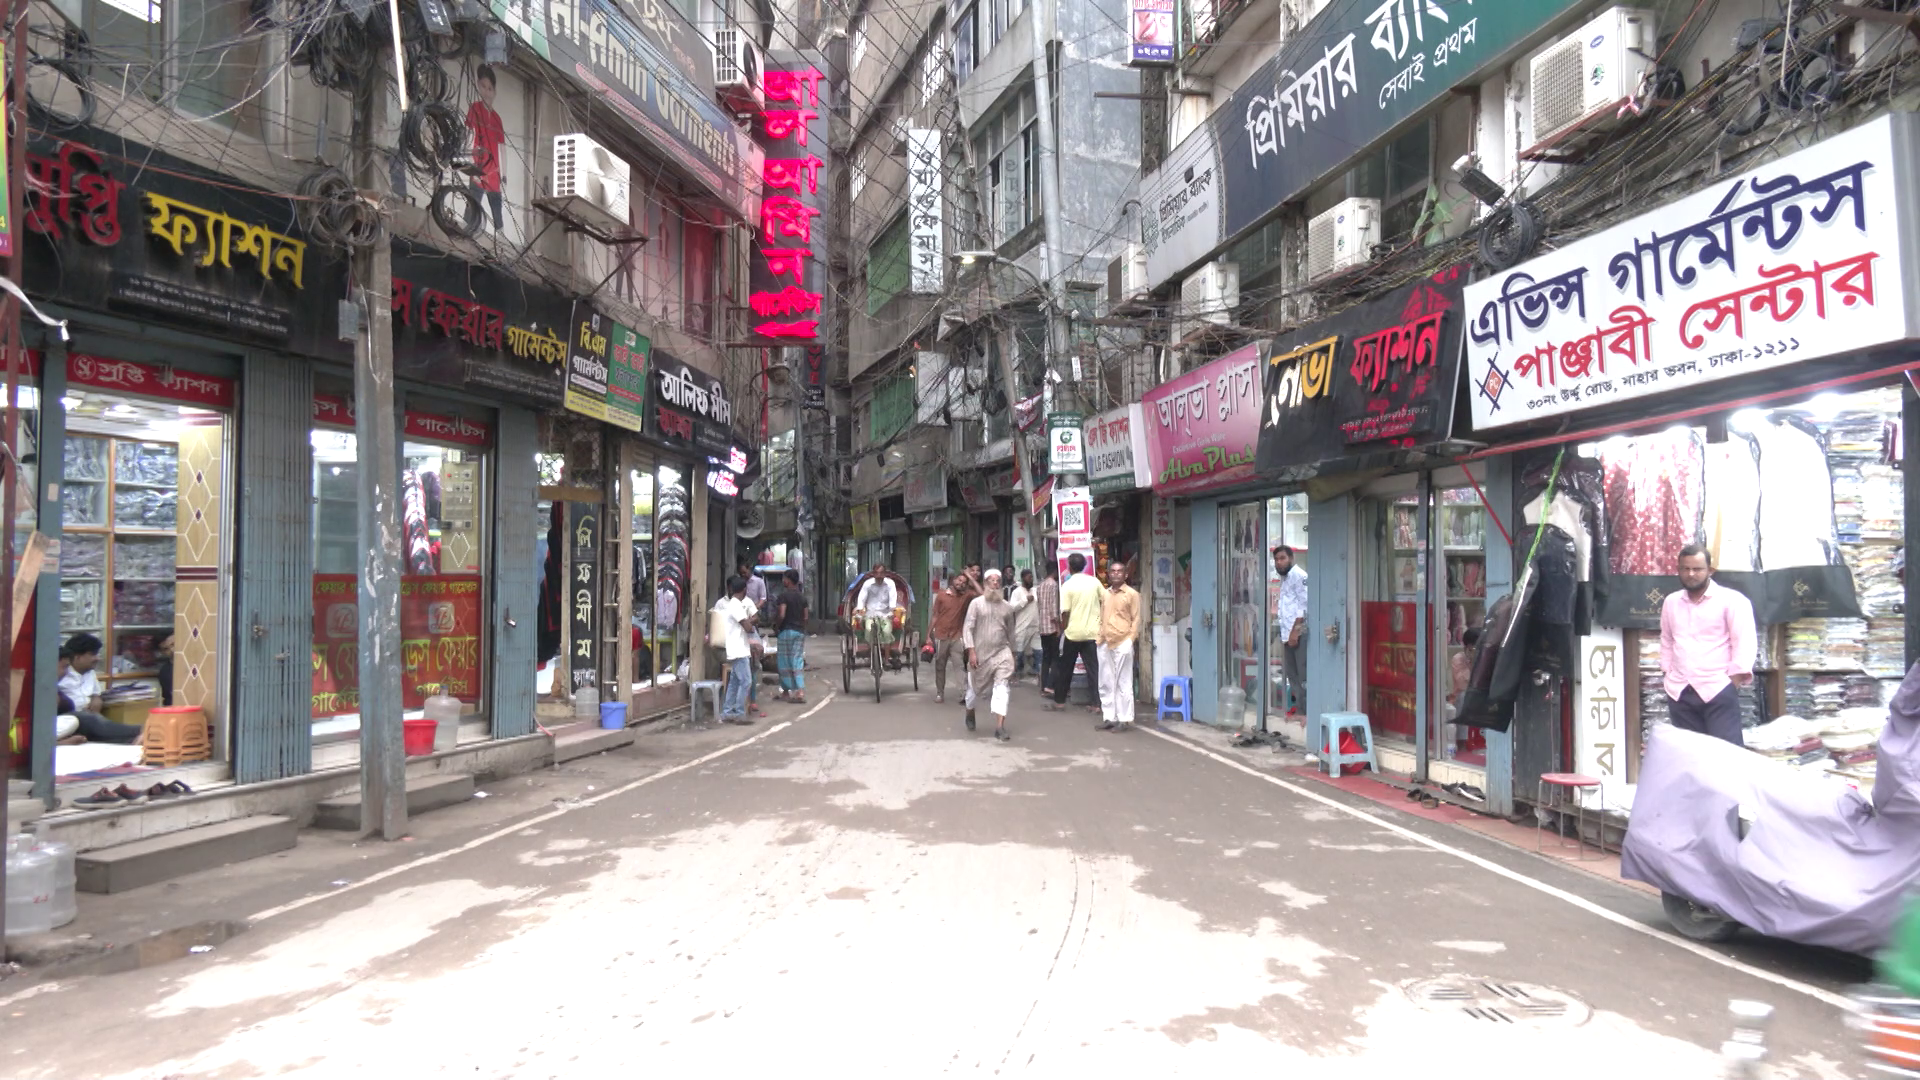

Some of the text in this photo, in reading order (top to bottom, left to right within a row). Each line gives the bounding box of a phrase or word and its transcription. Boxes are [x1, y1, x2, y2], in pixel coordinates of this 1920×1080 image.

[1246, 33, 1357, 169] প্রিমিয়ার
[1379, 17, 1478, 109] সেবাই প্রথম
[655, 65, 735, 177] Garments
[146, 191, 306, 289] ফ্যাশন
[1471, 161, 1874, 346] এভিন্স গার্মেন্টস
[420, 288, 505, 350] ফেয়ার
[1350, 311, 1444, 392] ফ্যাশন
[1514, 251, 1879, 387] পাঞ্জাবী সেন্টার
[1708, 336, 1800, 368] ঢাকা-১২১১
[660, 366, 709, 416] আলিফ
[710, 381, 731, 426] মীম
[1215, 360, 1258, 421] প্লাস
[1102, 449, 1125, 470] FASHION
[1159, 457, 1208, 484] Alva
[1202, 443, 1256, 472] Plus
[312, 684, 360, 713] গার্মেন্ট
[1589, 645, 1617, 776] সেন্টার
